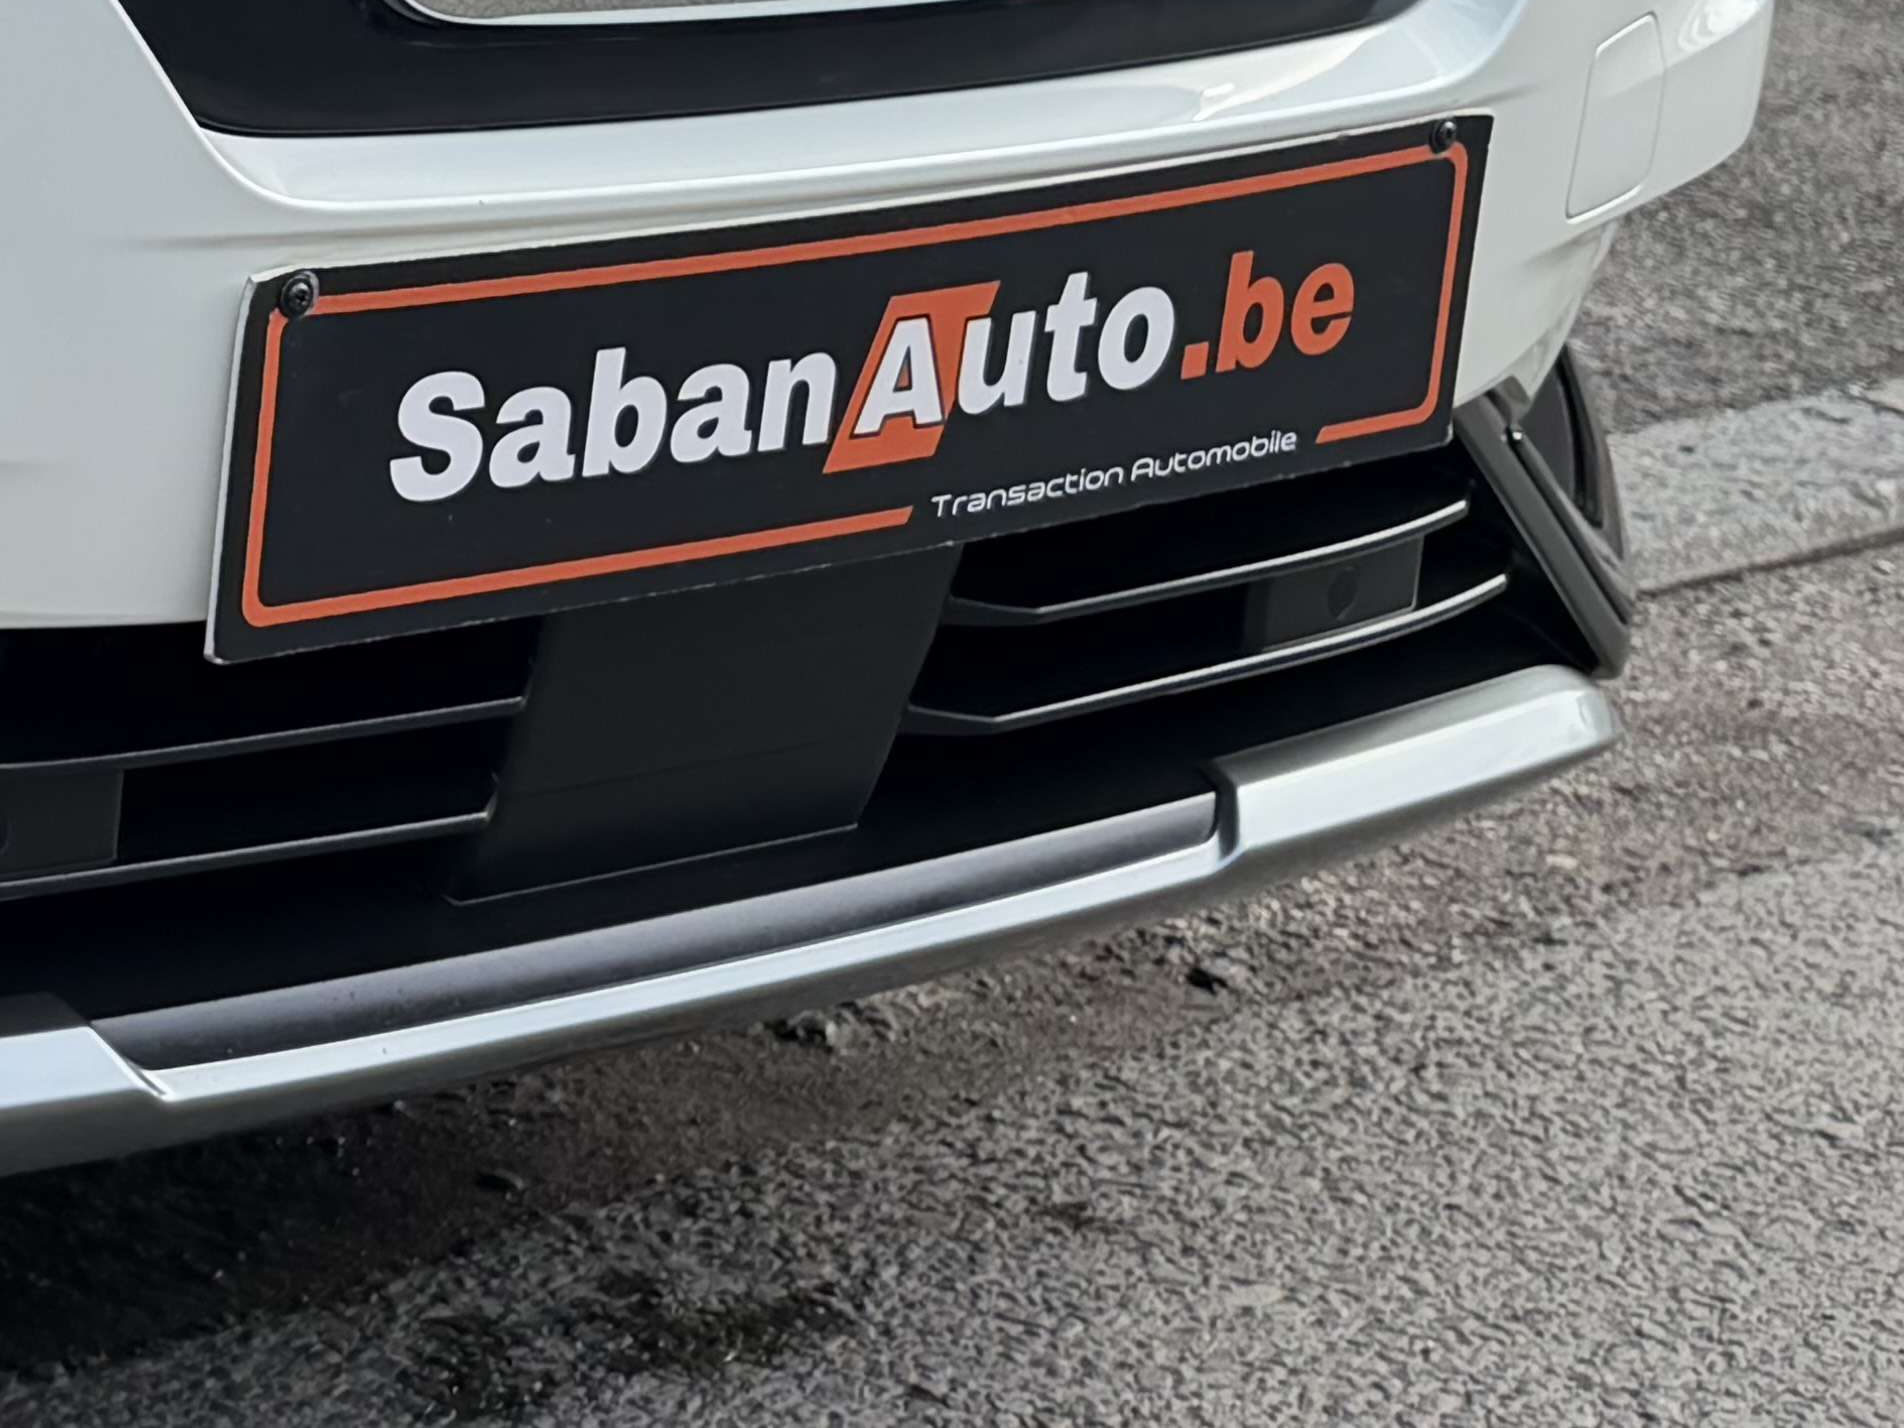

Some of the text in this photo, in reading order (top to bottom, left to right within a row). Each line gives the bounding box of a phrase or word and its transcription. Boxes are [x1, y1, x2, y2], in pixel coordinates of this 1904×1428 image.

[389, 250, 1355, 503] SabanAuto.be
[930, 428, 1299, 518] Transaction Automobile
